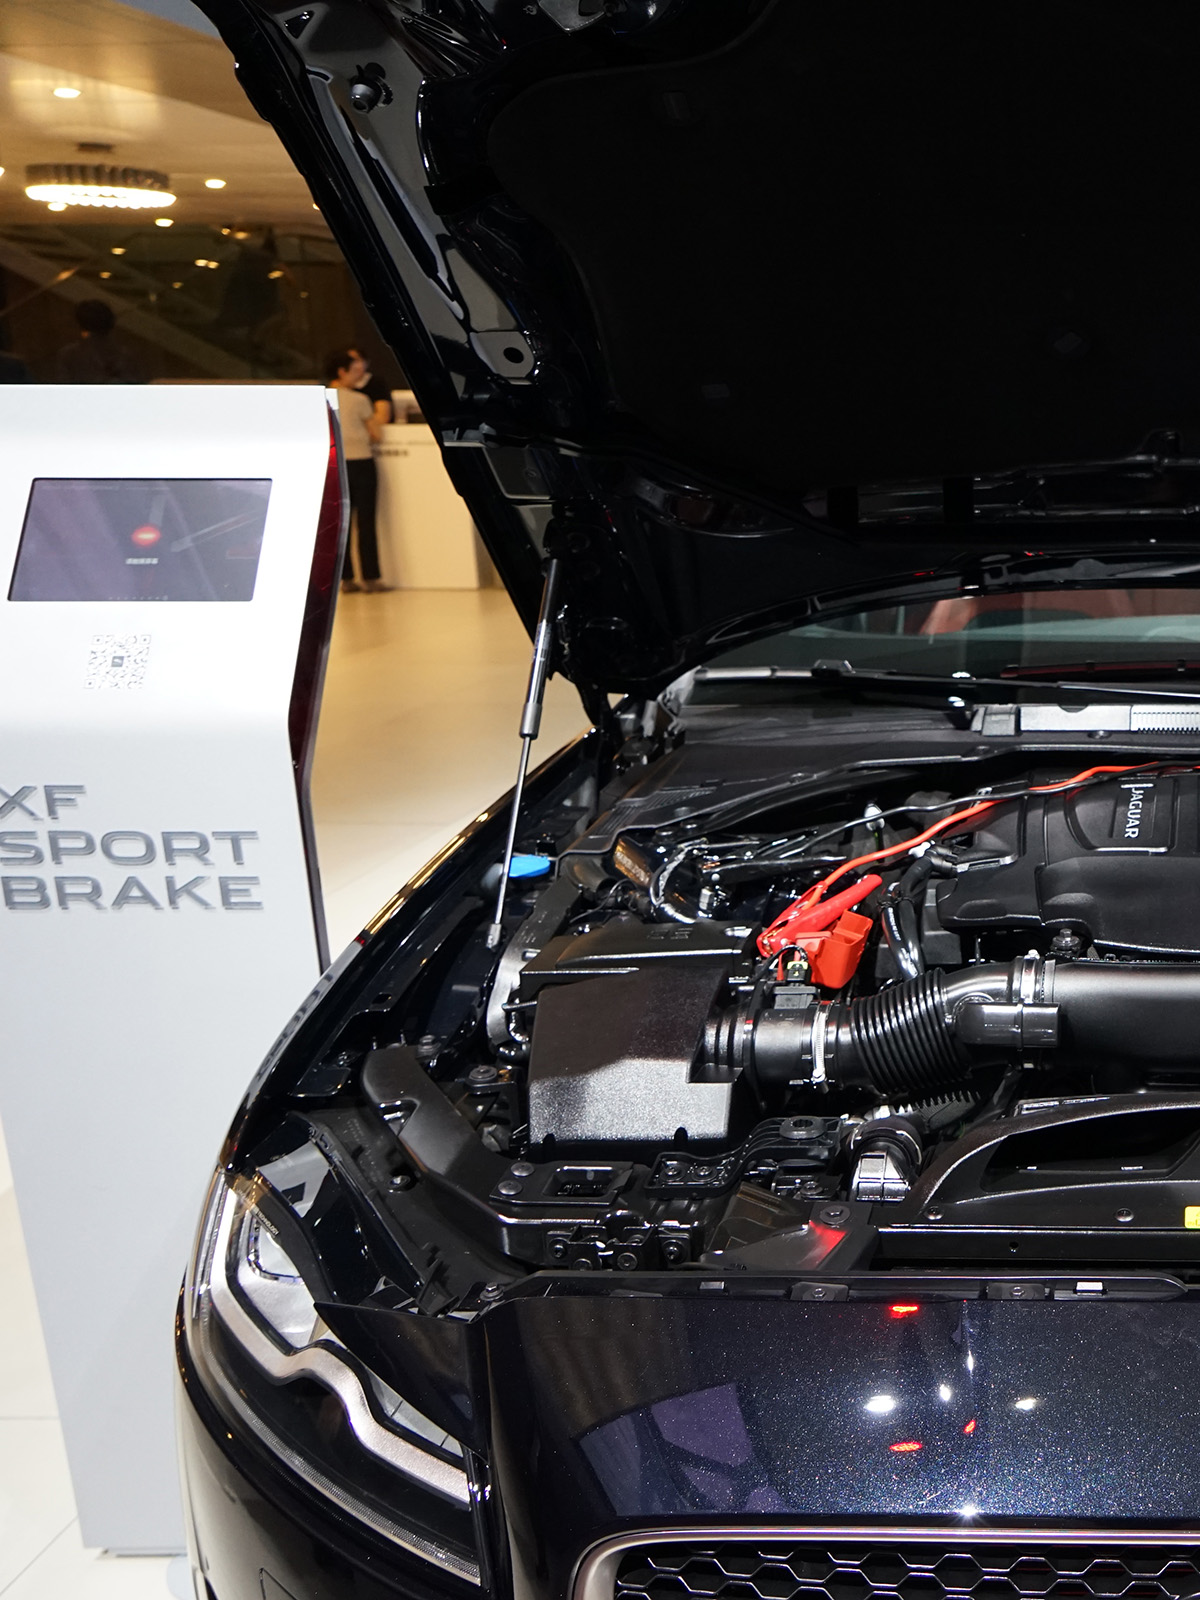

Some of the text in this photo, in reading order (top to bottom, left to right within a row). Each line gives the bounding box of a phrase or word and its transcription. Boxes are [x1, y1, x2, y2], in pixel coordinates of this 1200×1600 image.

[0, 785, 86, 821] XF
[1124, 787, 1144, 838] JAGUAR
[0, 830, 259, 866] SPORT
[1, 875, 264, 911] BRAKE
